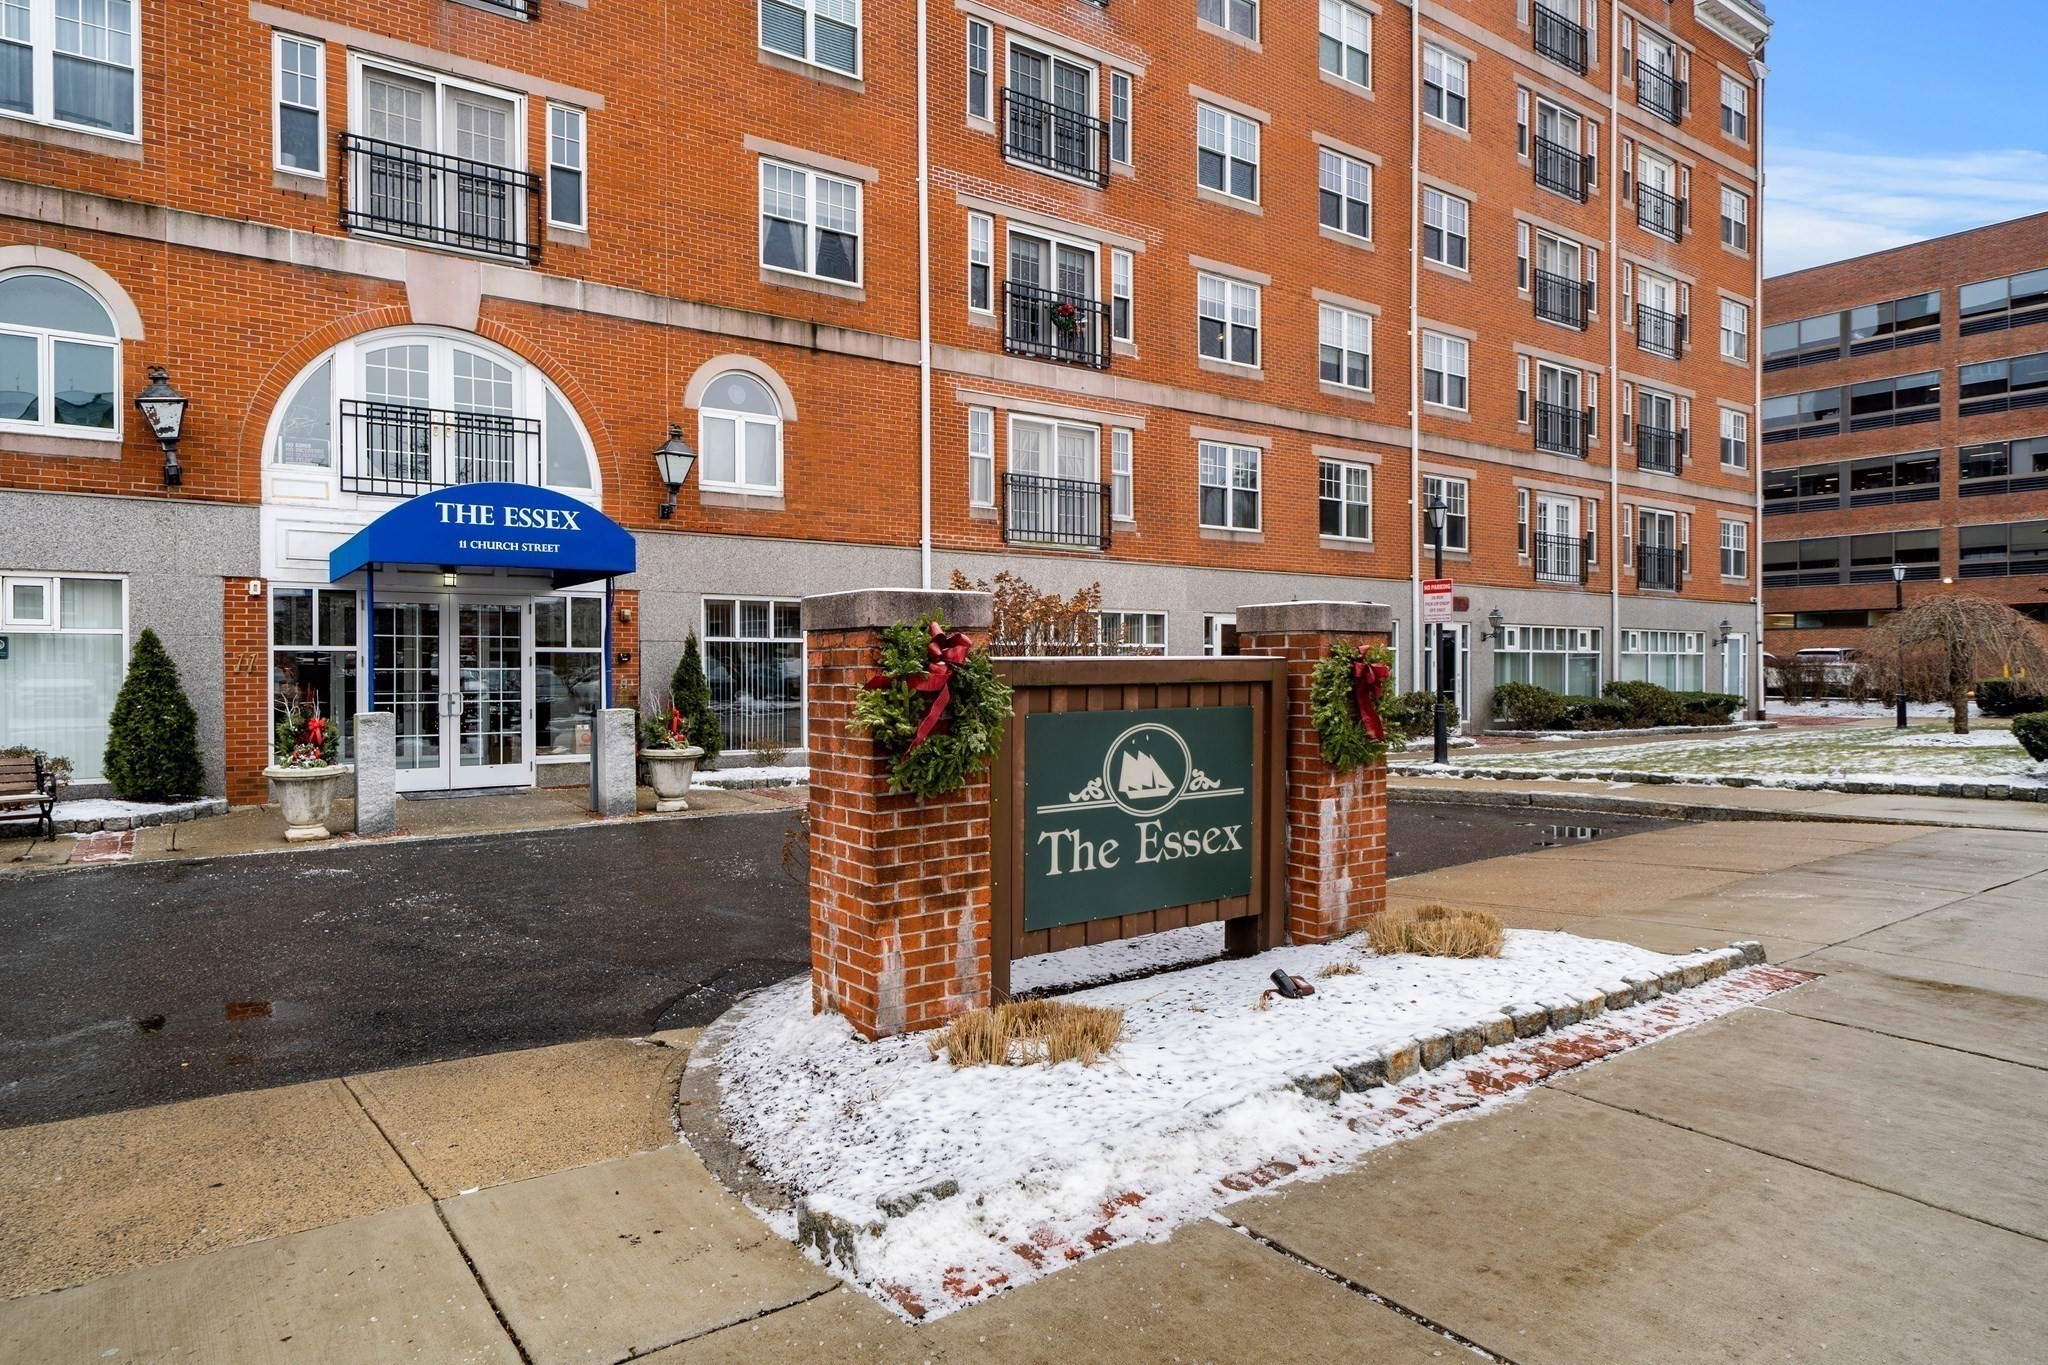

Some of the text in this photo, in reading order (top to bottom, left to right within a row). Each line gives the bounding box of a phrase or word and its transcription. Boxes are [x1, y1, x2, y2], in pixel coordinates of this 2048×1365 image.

[435, 502, 582, 531] THE ESSEX
[459, 540, 561, 553] 11 CHURCH STREET
[1037, 819, 1243, 876] The Essex
